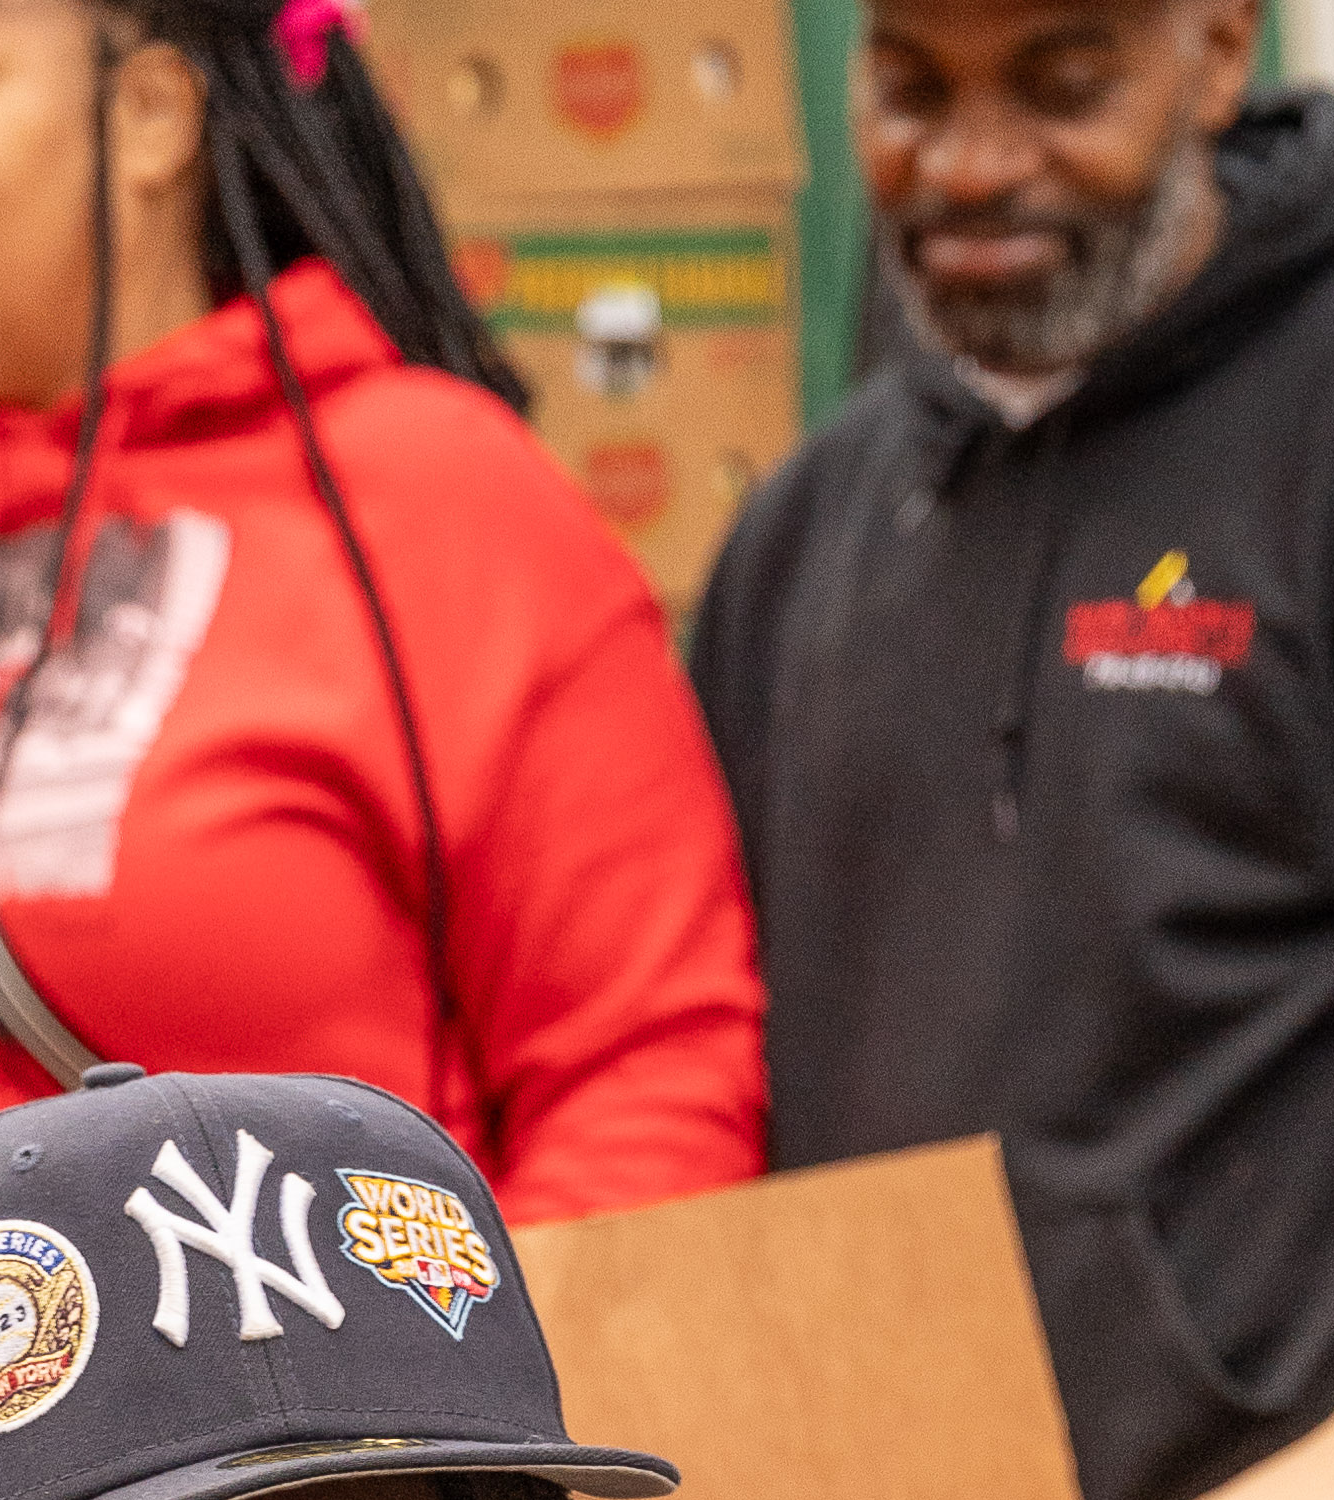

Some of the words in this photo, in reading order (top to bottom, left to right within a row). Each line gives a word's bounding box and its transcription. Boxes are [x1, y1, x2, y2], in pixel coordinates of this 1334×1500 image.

[351, 1178, 470, 1231] WORLD
[345, 1210, 497, 1285] SERIES
[15, 1358, 67, 1388] YORK
